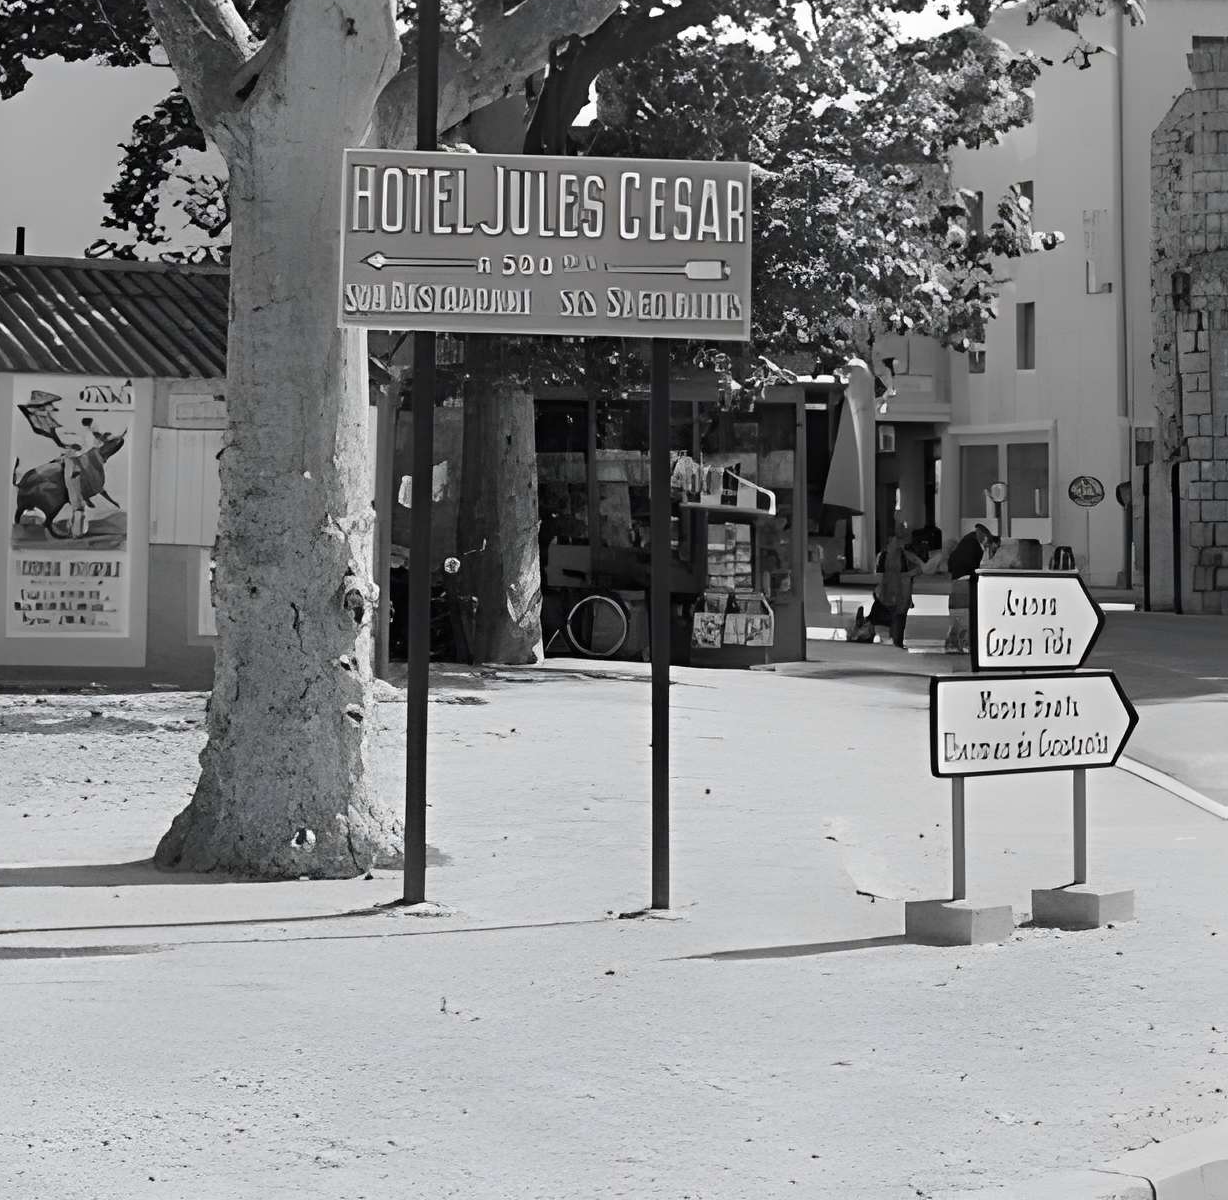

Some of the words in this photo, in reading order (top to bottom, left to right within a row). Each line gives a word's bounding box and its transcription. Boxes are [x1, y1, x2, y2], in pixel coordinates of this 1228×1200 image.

[350, 163, 473, 235] HOTEL
[477, 164, 605, 239] JULES
[619, 170, 745, 243] CESAR
